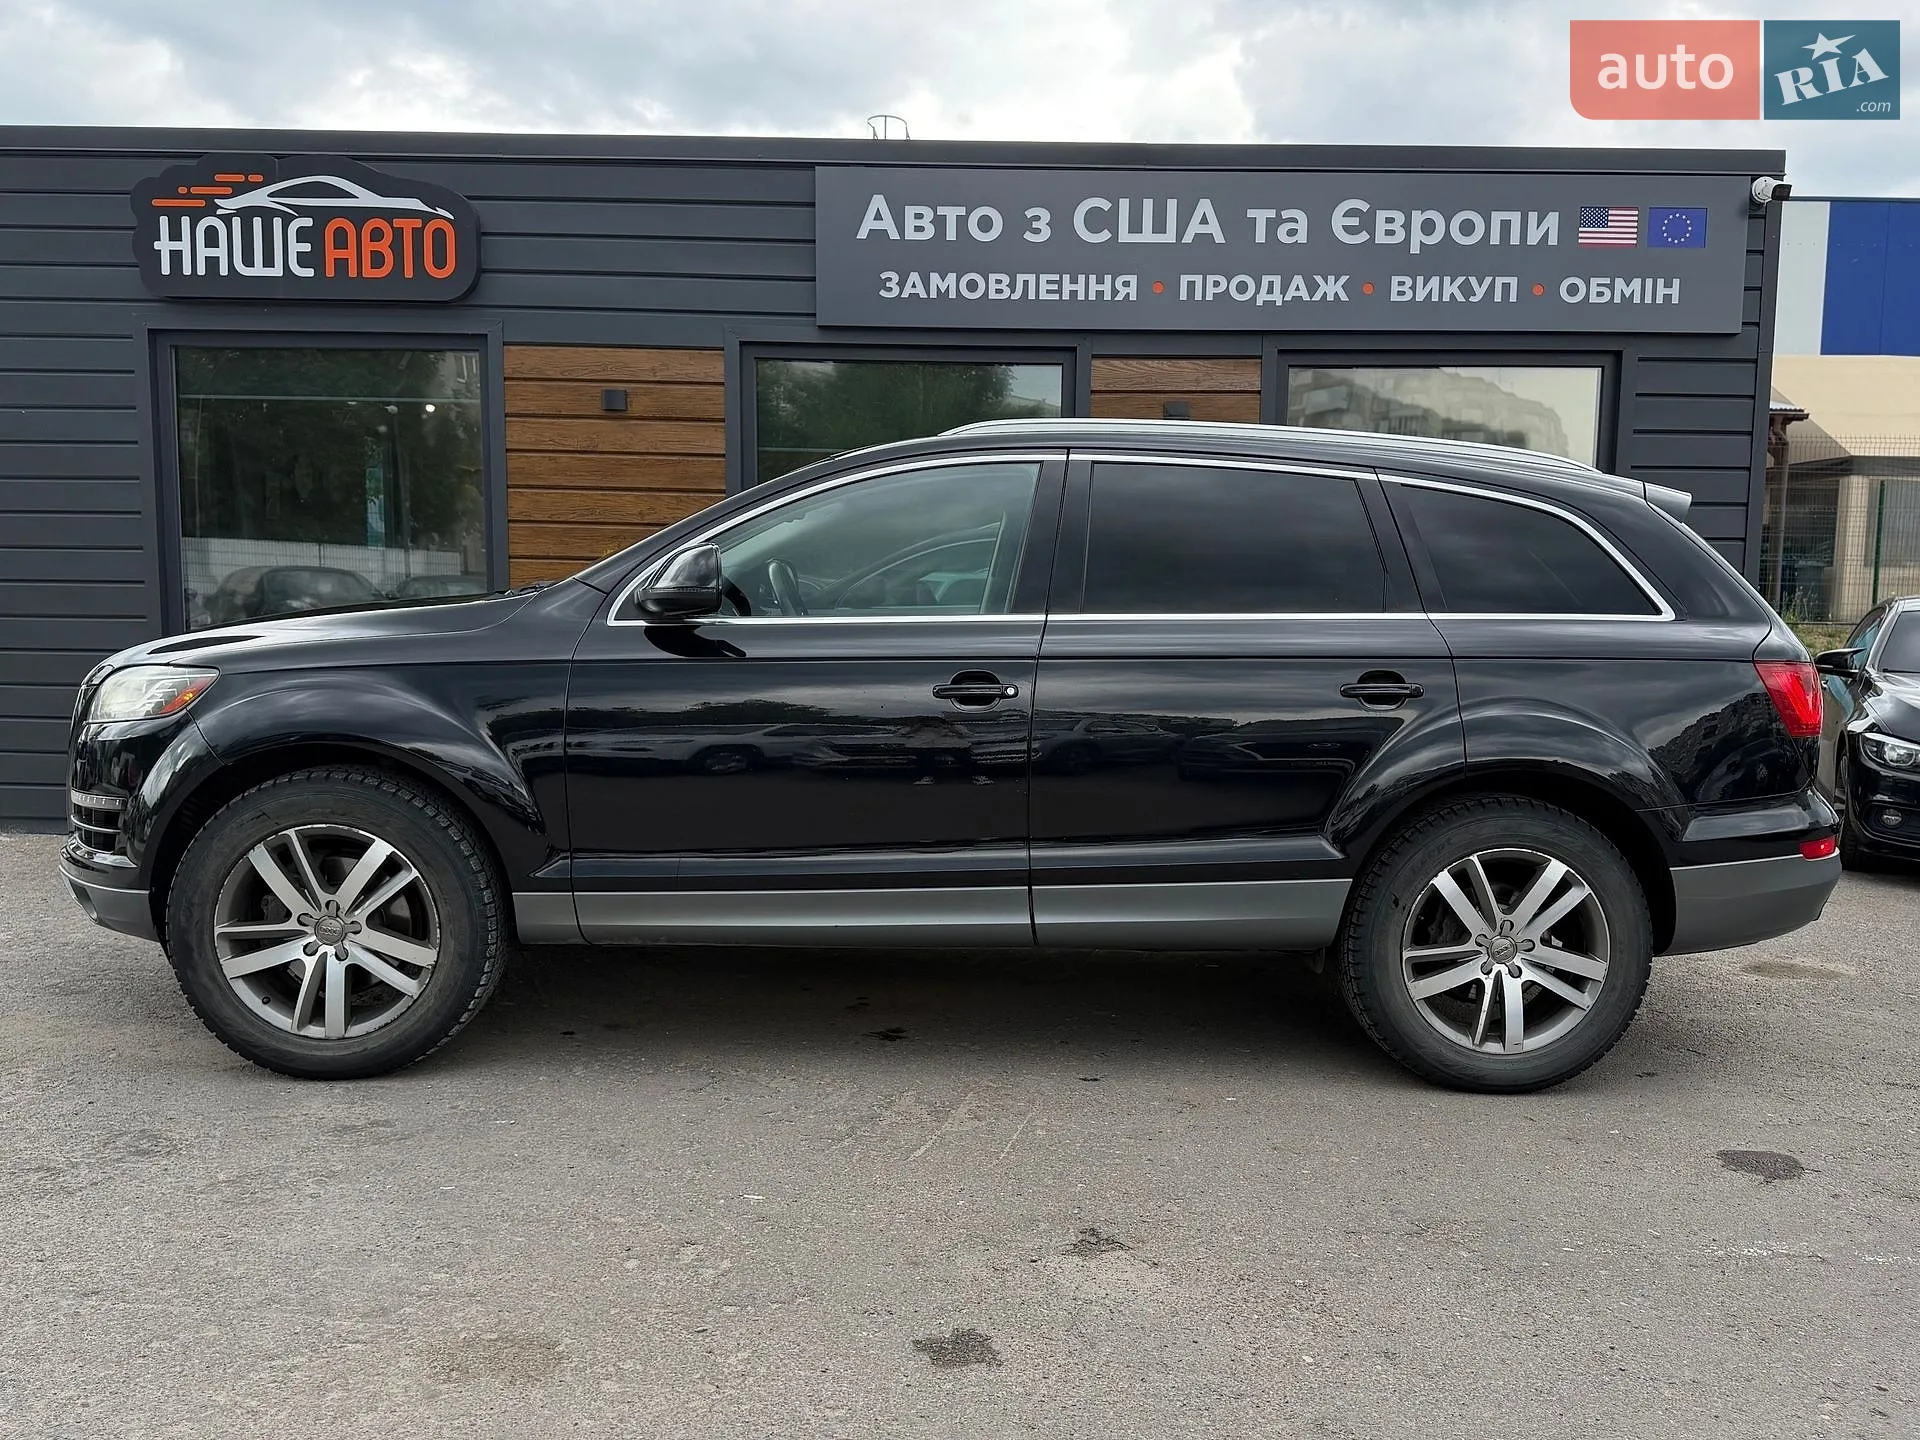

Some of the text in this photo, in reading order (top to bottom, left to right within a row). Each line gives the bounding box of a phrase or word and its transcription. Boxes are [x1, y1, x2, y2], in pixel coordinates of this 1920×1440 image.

[154, 215, 456, 279] НАШЕ АВТО
[856, 194, 1560, 254] Авто з США та Європи
[879, 271, 1681, 306] ЗАМОВЛЕННЯ ПРОДАЖ ВИКУП ОБМІН
